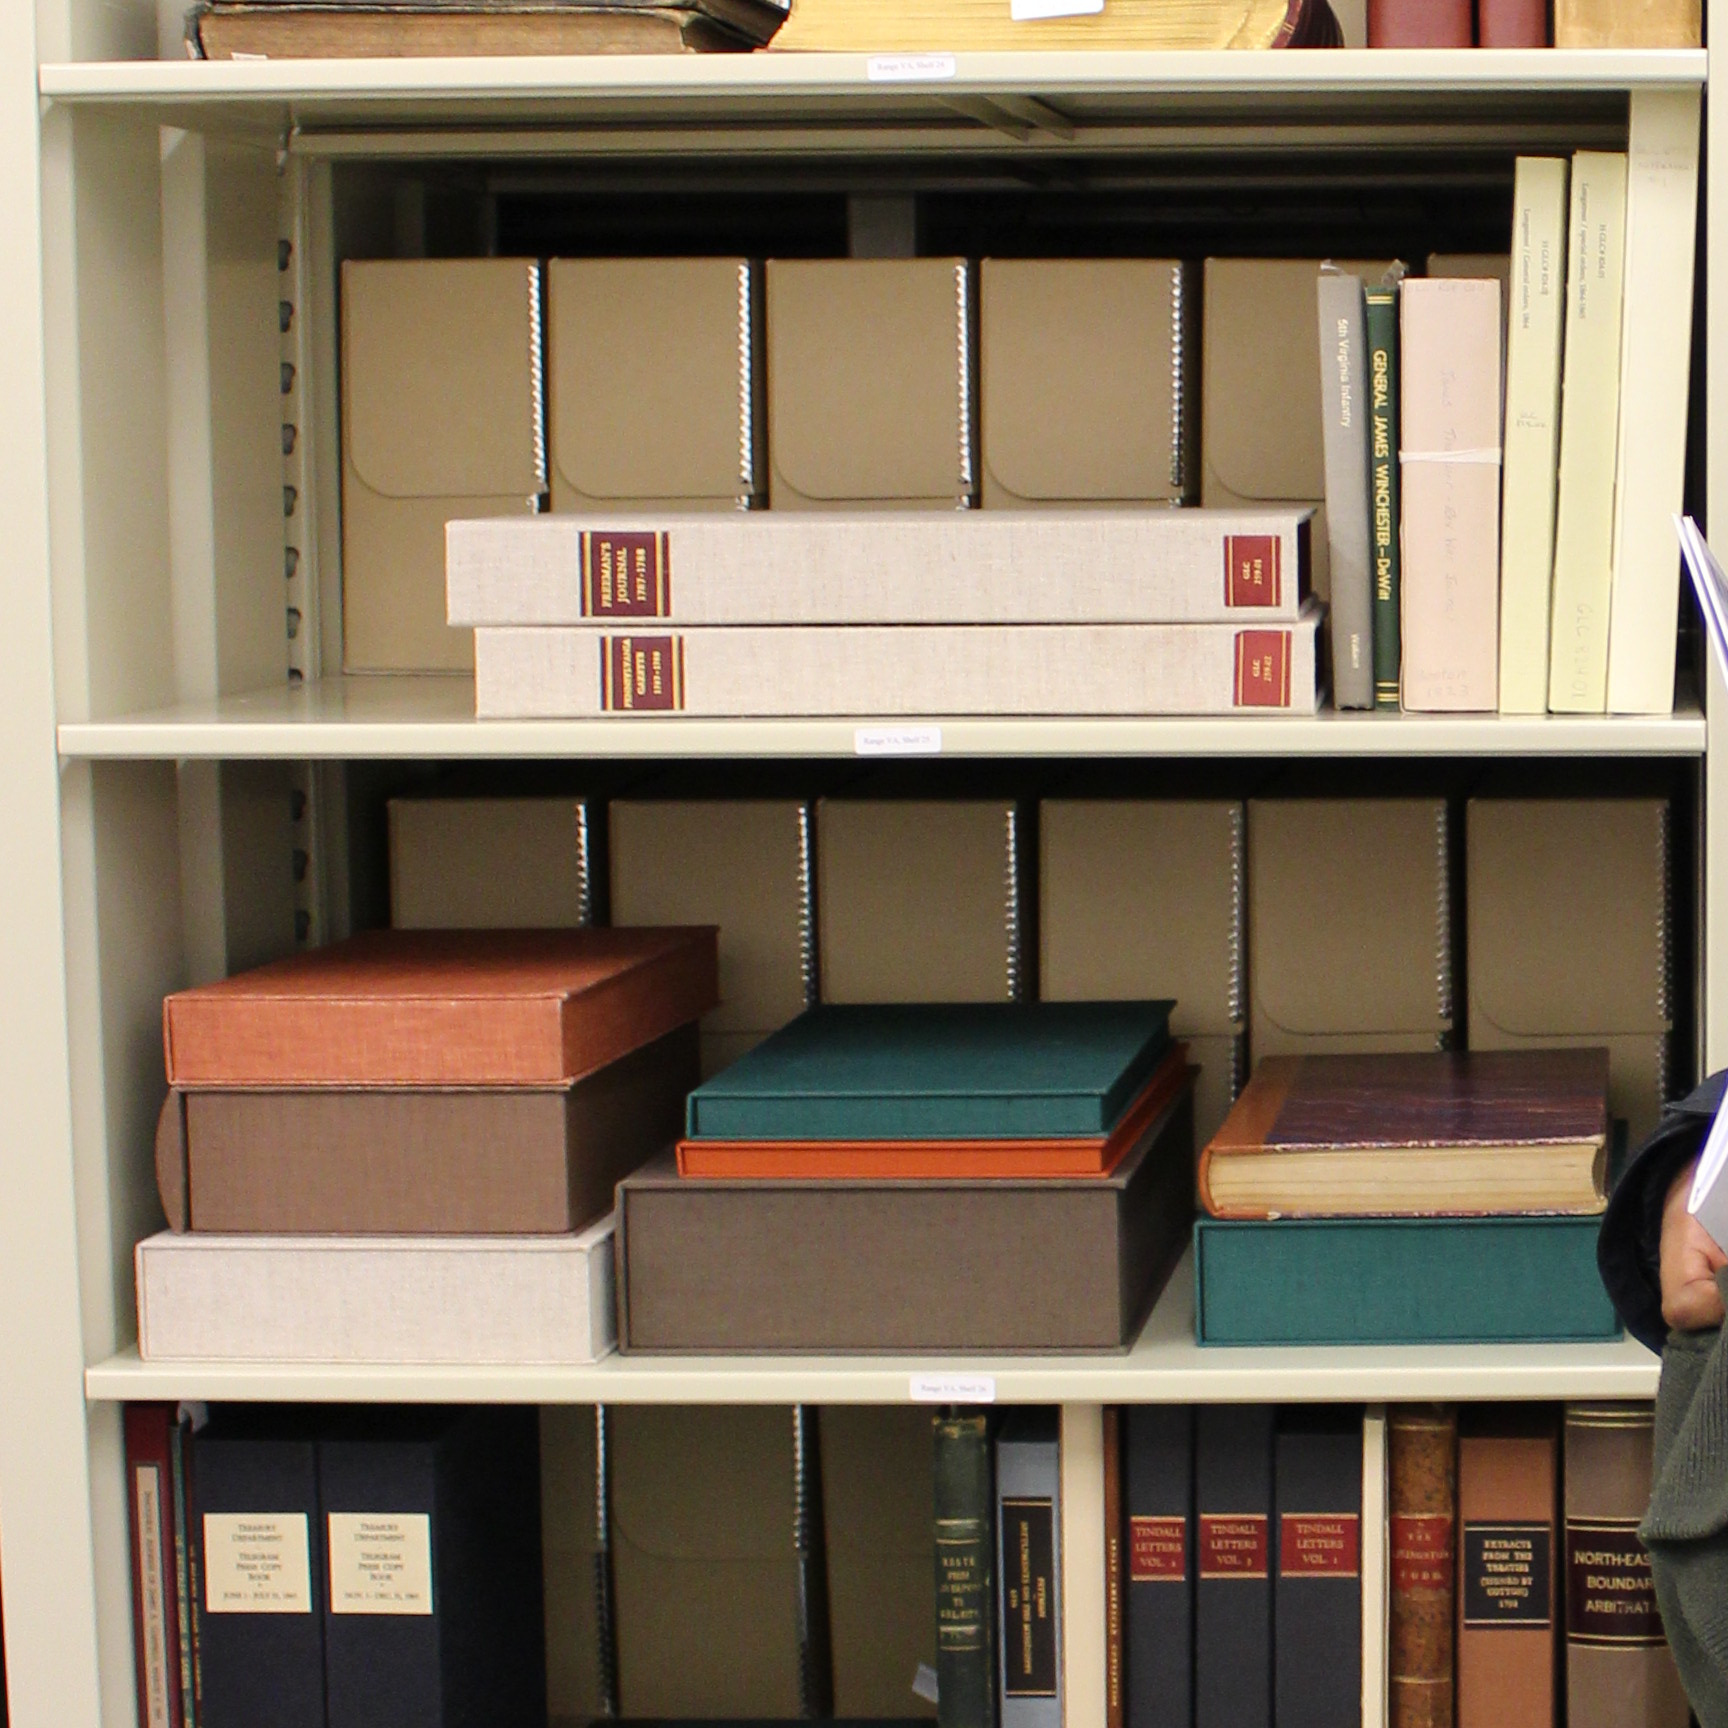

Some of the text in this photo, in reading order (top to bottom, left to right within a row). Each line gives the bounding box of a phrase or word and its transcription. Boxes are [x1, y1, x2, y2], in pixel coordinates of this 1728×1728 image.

[1337, 319, 1352, 428] 5th Virginia Infantry
[1373, 350, 1389, 458] GENERAL JAMES
[600, 541, 612, 608] FREEMAN'S
[616, 547, 630, 604] JOURNAL
[1576, 602, 1594, 637] GLC
[622, 638, 633, 708] PENNSYLVANIA
[635, 651, 646, 696] GAZETTE
[1135, 1527, 1181, 1538] TINDALL
[1211, 1524, 1258, 1535] TINDALL
[1296, 1523, 1344, 1535] TINDALL
[1135, 1542, 1182, 1552] LETTERS
[1211, 1539, 1257, 1550] LETTERS
[1296, 1539, 1344, 1549] LETTERS
[1483, 1539, 1532, 1549] EXTRACTS
[1217, 1554, 1241, 1565] VOL.
[1302, 1553, 1327, 1564] VOL.
[1482, 1552, 1533, 1561] FROM THE
[1574, 1551, 1652, 1566] NORTH-EAS
[1140, 1557, 1165, 1568] VOL.
[1521, 1577, 1533, 1585] BY
[1587, 1576, 1654, 1590] BOUNDAR
[1585, 1600, 1650, 1613] ARBITRAT
